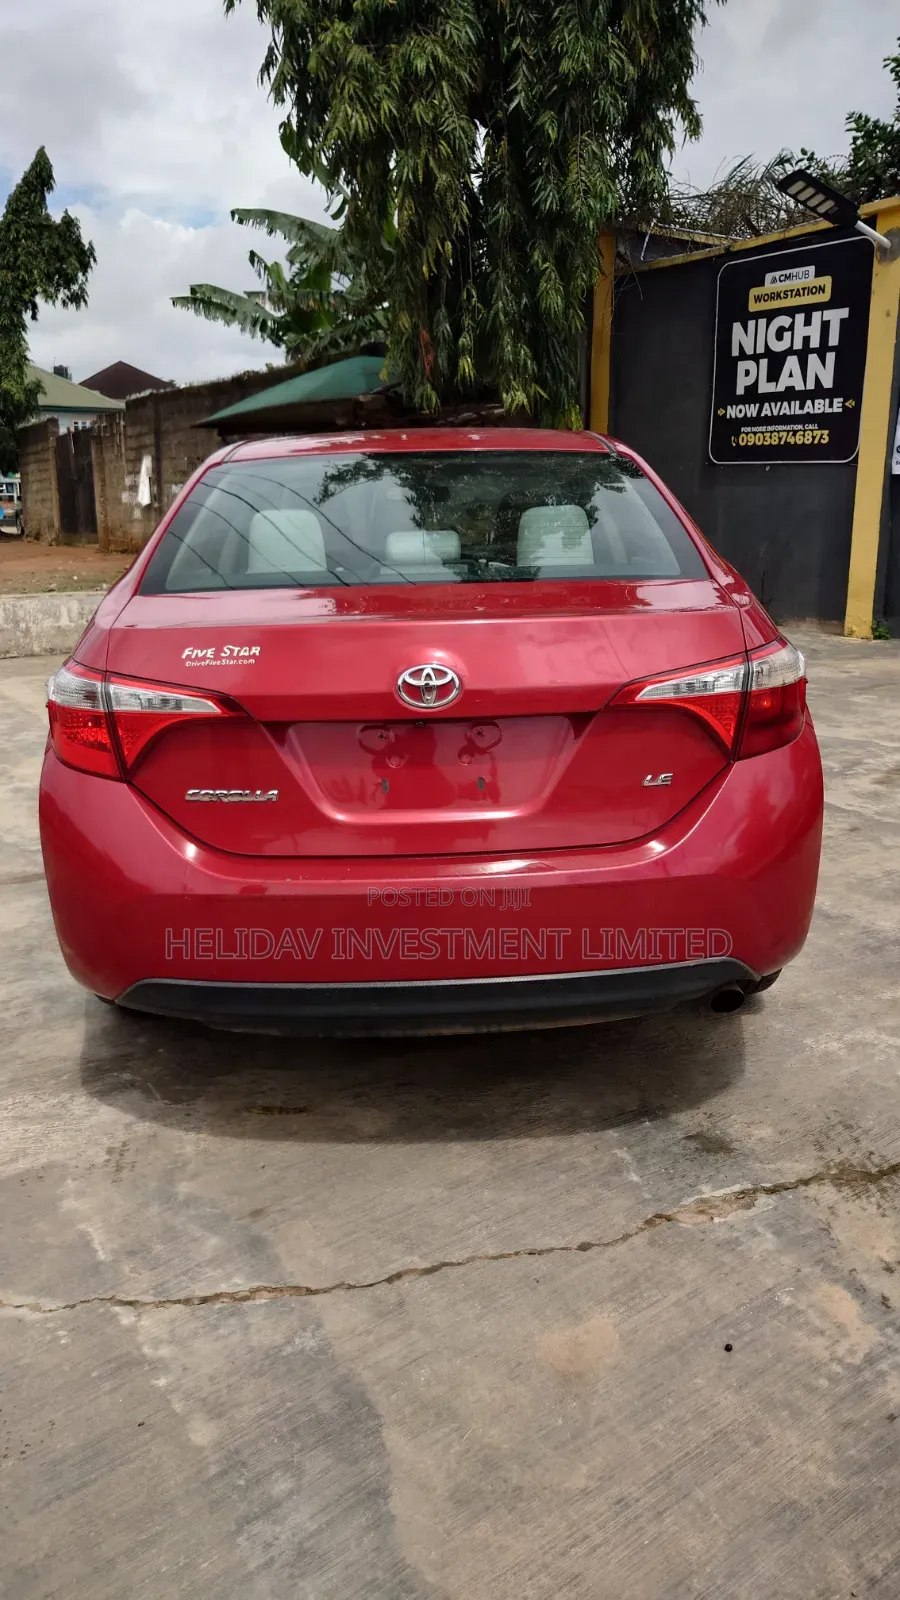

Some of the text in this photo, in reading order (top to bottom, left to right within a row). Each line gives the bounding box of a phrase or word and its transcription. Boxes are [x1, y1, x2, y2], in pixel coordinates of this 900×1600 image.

[778, 269, 811, 283] CMHUB
[753, 284, 826, 304] WORKSTATION
[731, 307, 850, 357] NIGHT
[736, 352, 836, 395] PLAN
[726, 398, 844, 419] NOW AVAILABLE
[738, 430, 830, 446] 09038746873
[181, 645, 261, 659] FIVE STAR
[185, 659, 256, 667] DriveFiveStar.com
[642, 773, 674, 787] LE
[185, 789, 279, 803] COROLLA
